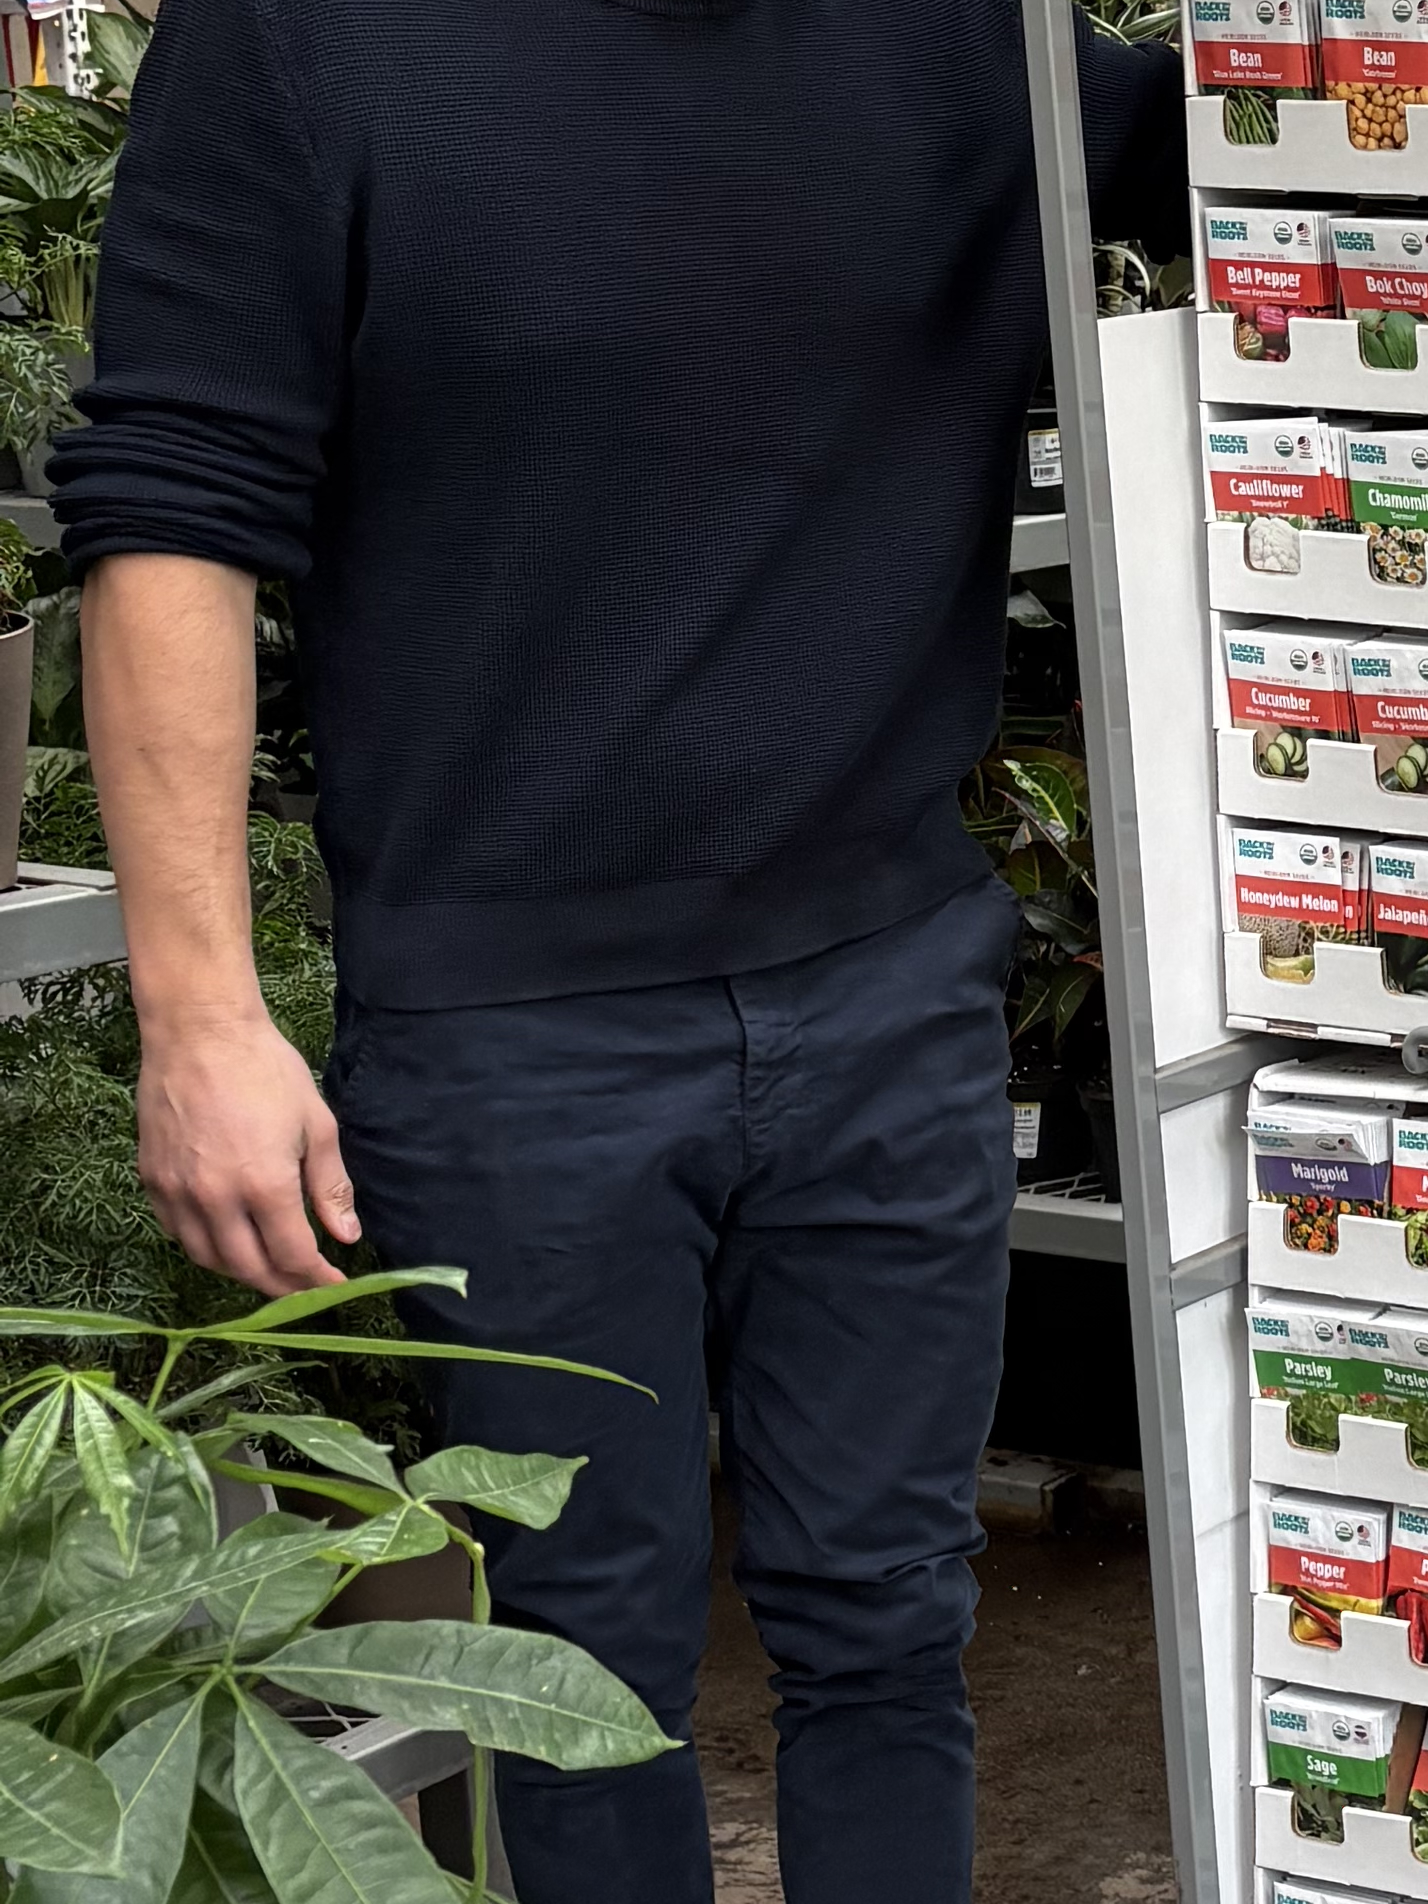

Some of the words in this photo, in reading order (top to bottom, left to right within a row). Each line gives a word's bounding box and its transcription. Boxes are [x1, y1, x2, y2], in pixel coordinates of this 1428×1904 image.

[1366, 276, 1394, 293] Bok
[1395, 278, 1428, 305] Choy
[1230, 479, 1303, 498] Cauliflower
[1251, 688, 1310, 714] Cucumber
[1241, 888, 1299, 908] Honeydew
[1302, 894, 1338, 912] Melon
[1291, 1163, 1348, 1186] Marigold
[1283, 1359, 1331, 1386] Parsley
[1307, 1755, 1337, 1775] Sage
